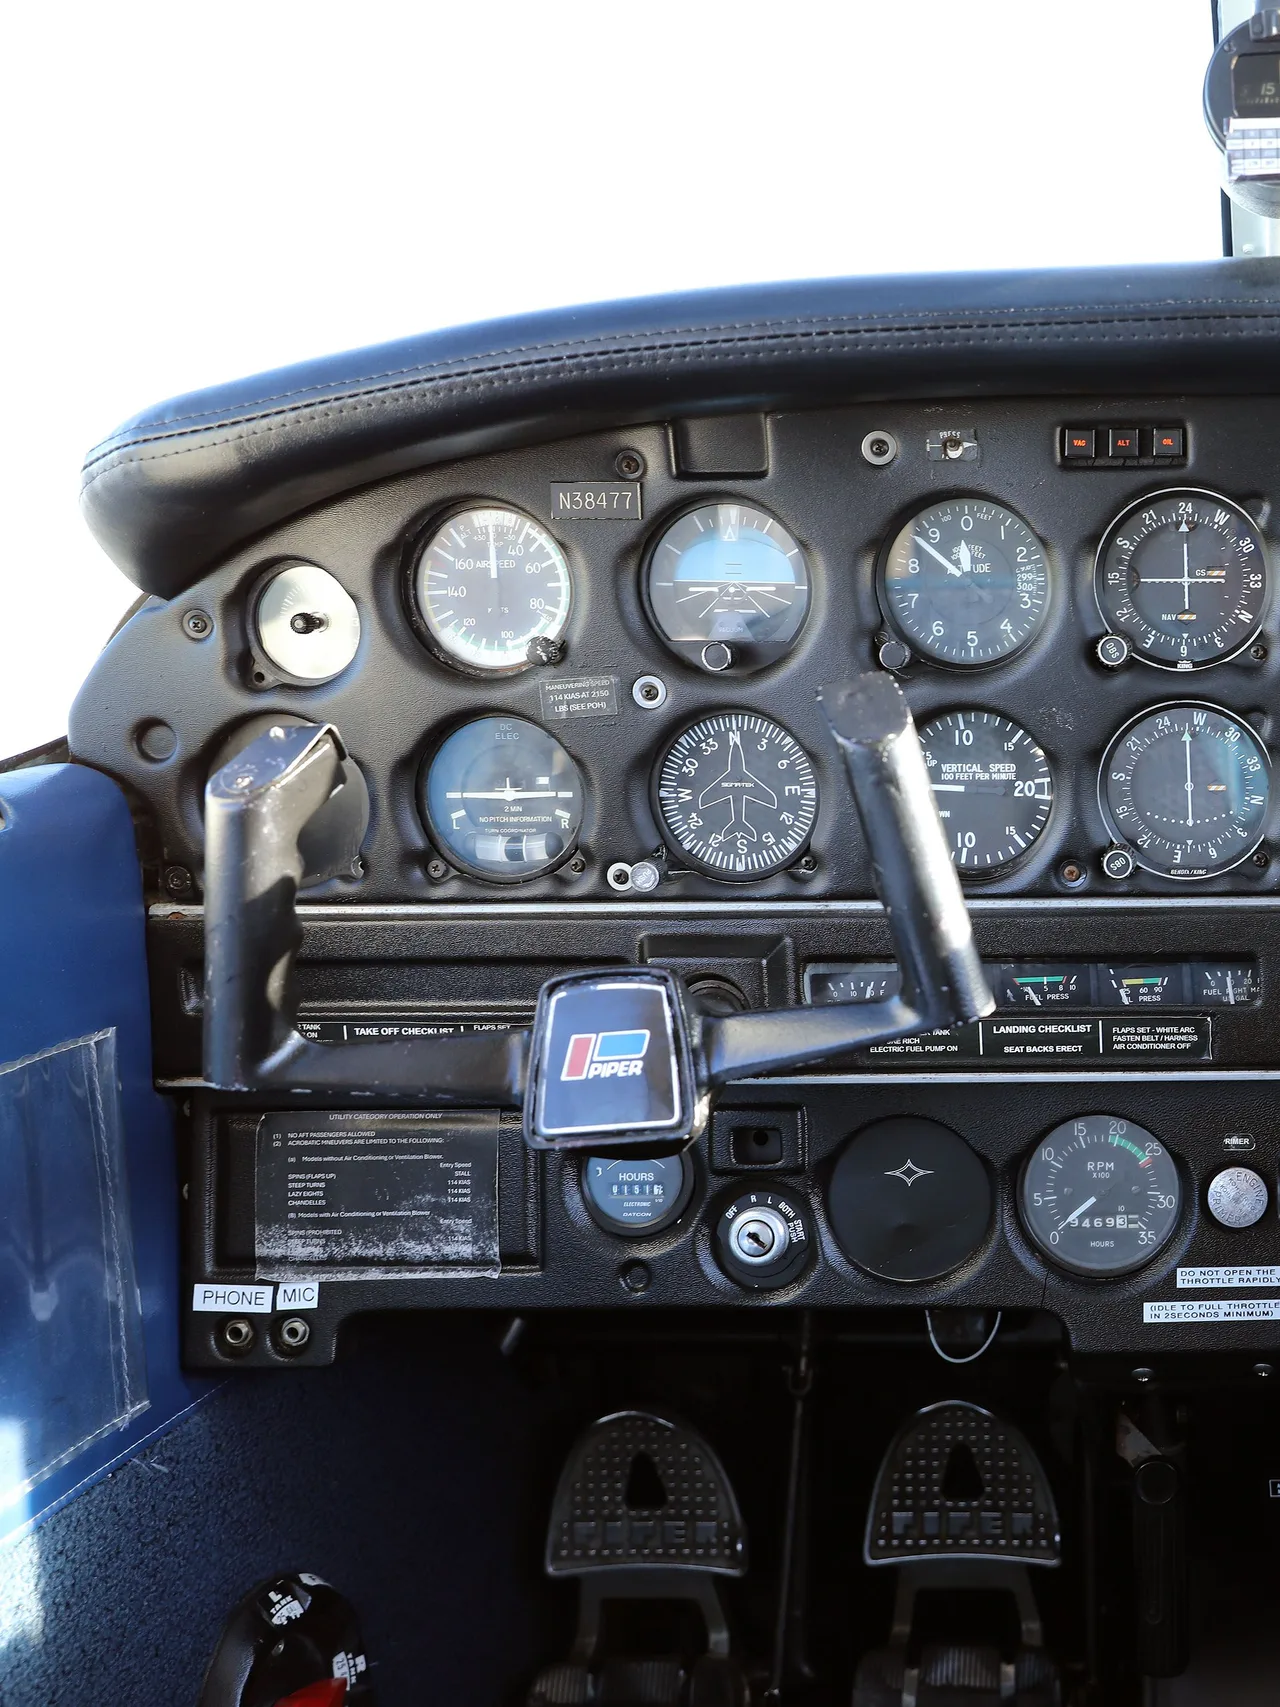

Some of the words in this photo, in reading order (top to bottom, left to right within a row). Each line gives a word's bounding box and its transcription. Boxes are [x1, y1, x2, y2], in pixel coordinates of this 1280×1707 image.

[1261, 83, 1275, 95] 15
[559, 492, 632, 510] N38477
[1178, 503, 1192, 514] 24
[1213, 509, 1230, 525] W
[1016, 547, 1028, 562] 2
[455, 559, 474, 570] 160
[525, 562, 541, 574] 60
[908, 559, 920, 573] 8
[447, 586, 467, 597] 140
[967, 631, 978, 647] 5
[549, 693, 563, 702] 114
[563, 692, 580, 700] KIAS
[580, 691, 590, 699] AT
[591, 690, 609, 698] 2150
[554, 704, 569, 713] LBS
[569, 703, 586, 712] (SEE
[587, 701, 607, 711] POH)
[1193, 712, 1207, 726] W
[495, 732, 520, 740] ELEC
[955, 730, 974, 746] 10
[1224, 727, 1240, 742] 30
[699, 739, 719, 756] 33
[941, 764, 983, 773] VERTICAL
[989, 764, 1016, 773] SPEED
[785, 785, 801, 796] E
[1014, 781, 1035, 797] 20
[993, 1025, 1036, 1034] LANDING
[1038, 1025, 1092, 1033] CHECKLIST
[1164, 1034, 1198, 1042] HARNESS
[1025, 1045, 1054, 1053] BACKS
[1055, 1045, 1082, 1053] ERECT
[588, 1060, 644, 1079] PIPER
[1074, 1123, 1087, 1136] 15
[1109, 1122, 1127, 1134] 20
[1145, 1143, 1162, 1156] 25
[1087, 1162, 1115, 1171] RPM
[619, 1172, 654, 1181] HOURS
[725, 1205, 738, 1219] OFF
[778, 1201, 796, 1219] BOTH
[794, 1219, 806, 1241] START
[1090, 1240, 1115, 1248] HOURS
[1180, 1269, 1196, 1277] DO
[1200, 1269, 1220, 1277] NOT
[1256, 1268, 1276, 1276] THE
[1180, 1277, 1234, 1285] THROTTLE
[203, 1290, 265, 1306] PHONE
[283, 1287, 315, 1303] MIC
[1150, 1304, 1177, 1312] (IDLE
[1199, 1303, 1223, 1311] FULL
[1165, 1311, 1220, 1319] 2SECONDS
[1224, 1310, 1274, 1318] MINIMUM)
